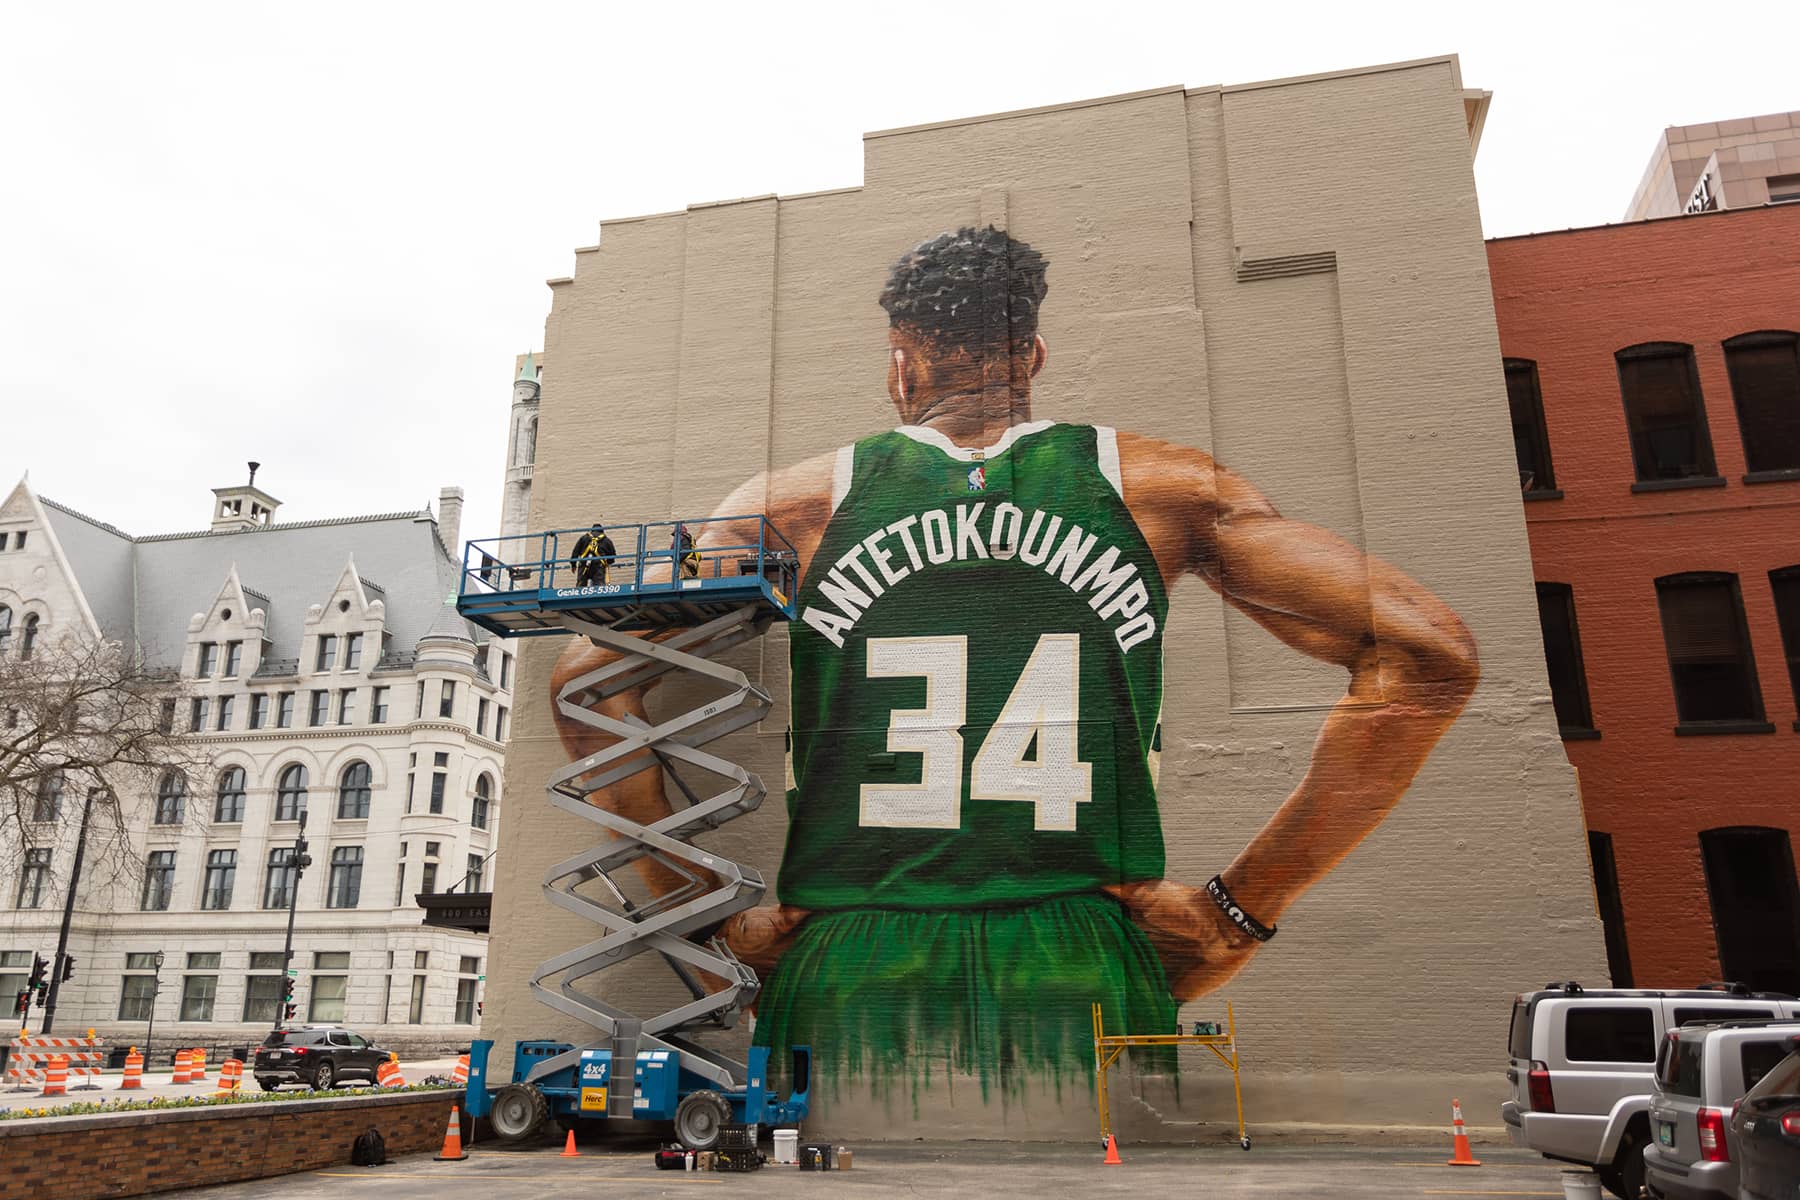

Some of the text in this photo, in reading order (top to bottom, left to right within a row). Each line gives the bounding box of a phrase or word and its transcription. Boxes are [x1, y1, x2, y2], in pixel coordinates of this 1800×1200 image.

[557, 584, 620, 597] Genie GS-5390
[801, 501, 1156, 655] ANTETOKOUNMPO
[858, 633, 1093, 832] 34
[584, 1063, 606, 1074] 4x4
